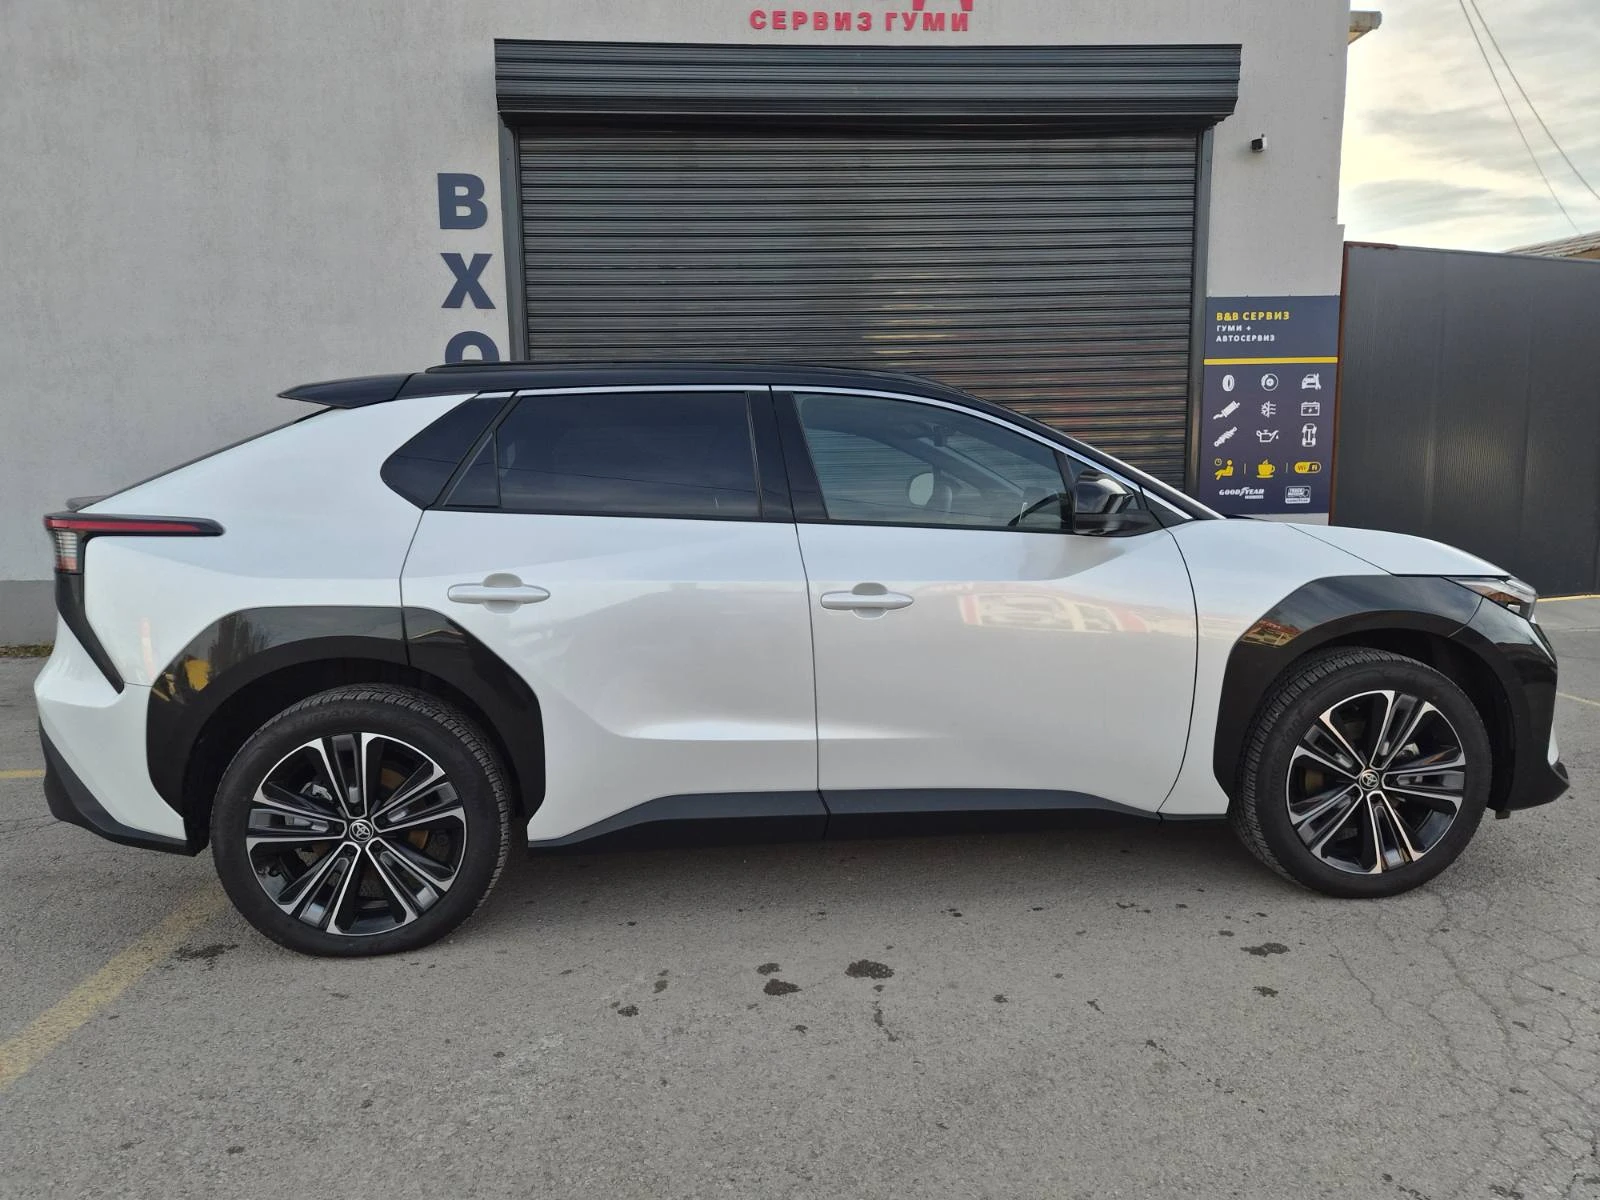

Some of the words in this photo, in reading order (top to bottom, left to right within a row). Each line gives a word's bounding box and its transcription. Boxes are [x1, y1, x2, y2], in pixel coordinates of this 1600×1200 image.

[750, 10, 872, 31] СЕРВИЗ
[885, 12, 969, 32] ГУМИ
[1242, 311, 1290, 321] СЕРВИЗ
[1216, 324, 1243, 332] ГУМИ
[1215, 334, 1276, 343] АВТОСЕРВИЗ
[1218, 486, 1265, 497] GOODYEAR
